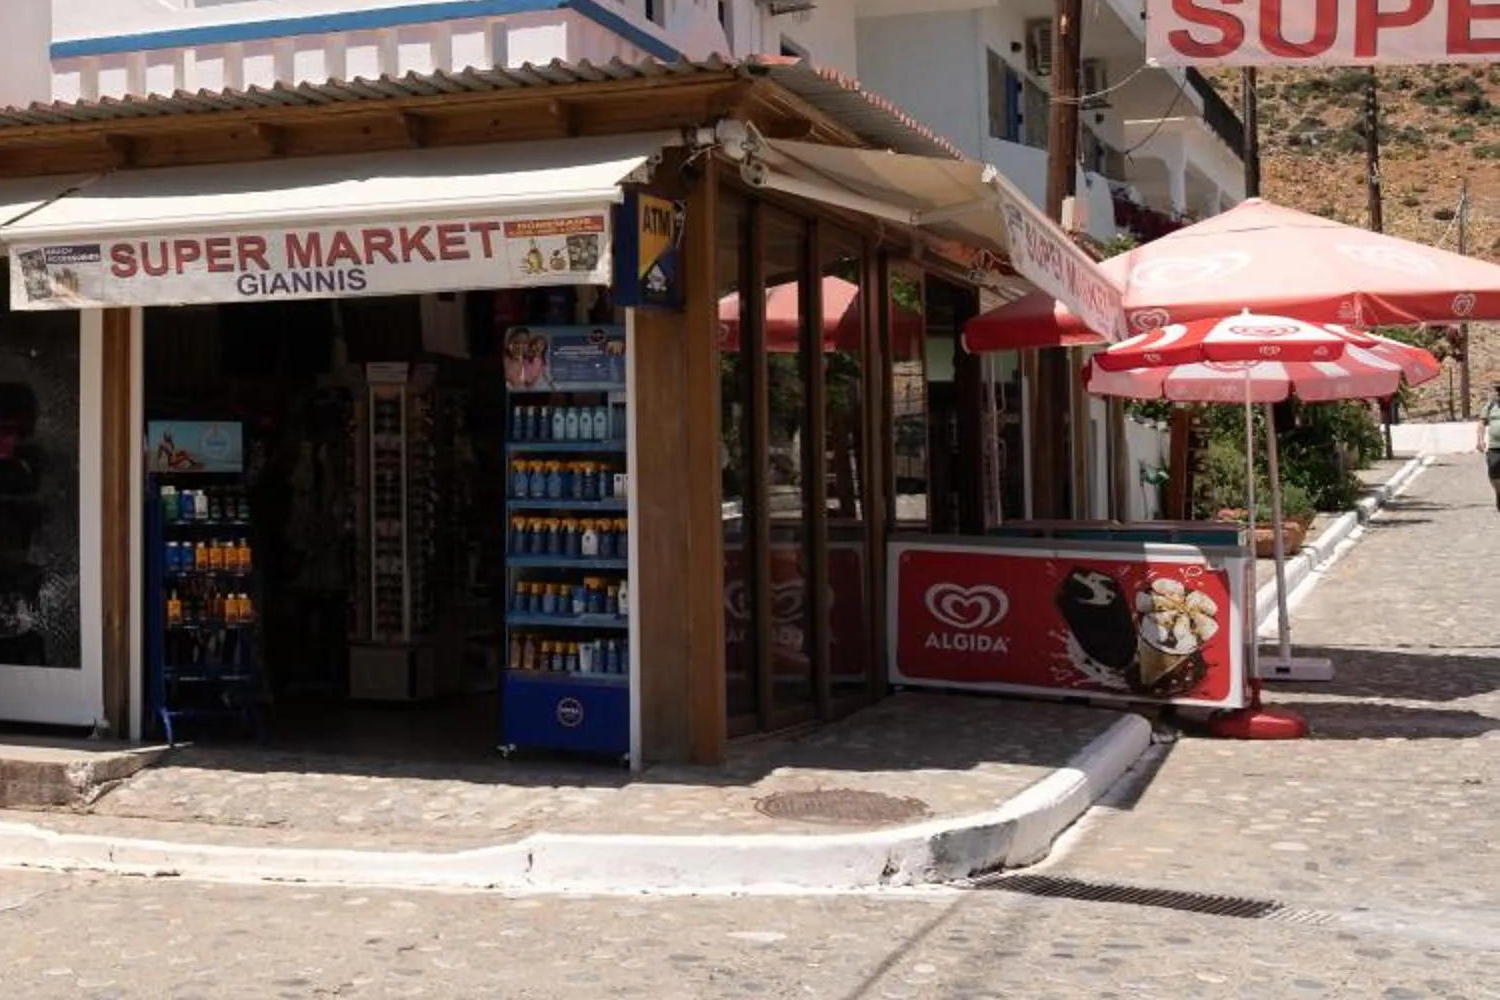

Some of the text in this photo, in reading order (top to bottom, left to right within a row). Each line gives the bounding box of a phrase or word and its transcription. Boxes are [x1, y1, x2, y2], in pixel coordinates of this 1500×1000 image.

[642, 204, 672, 237] ATM
[110, 222, 500, 278] SUPER MARKET
[237, 268, 367, 296] GIANNIS
[924, 632, 1009, 653] ALGIDA
